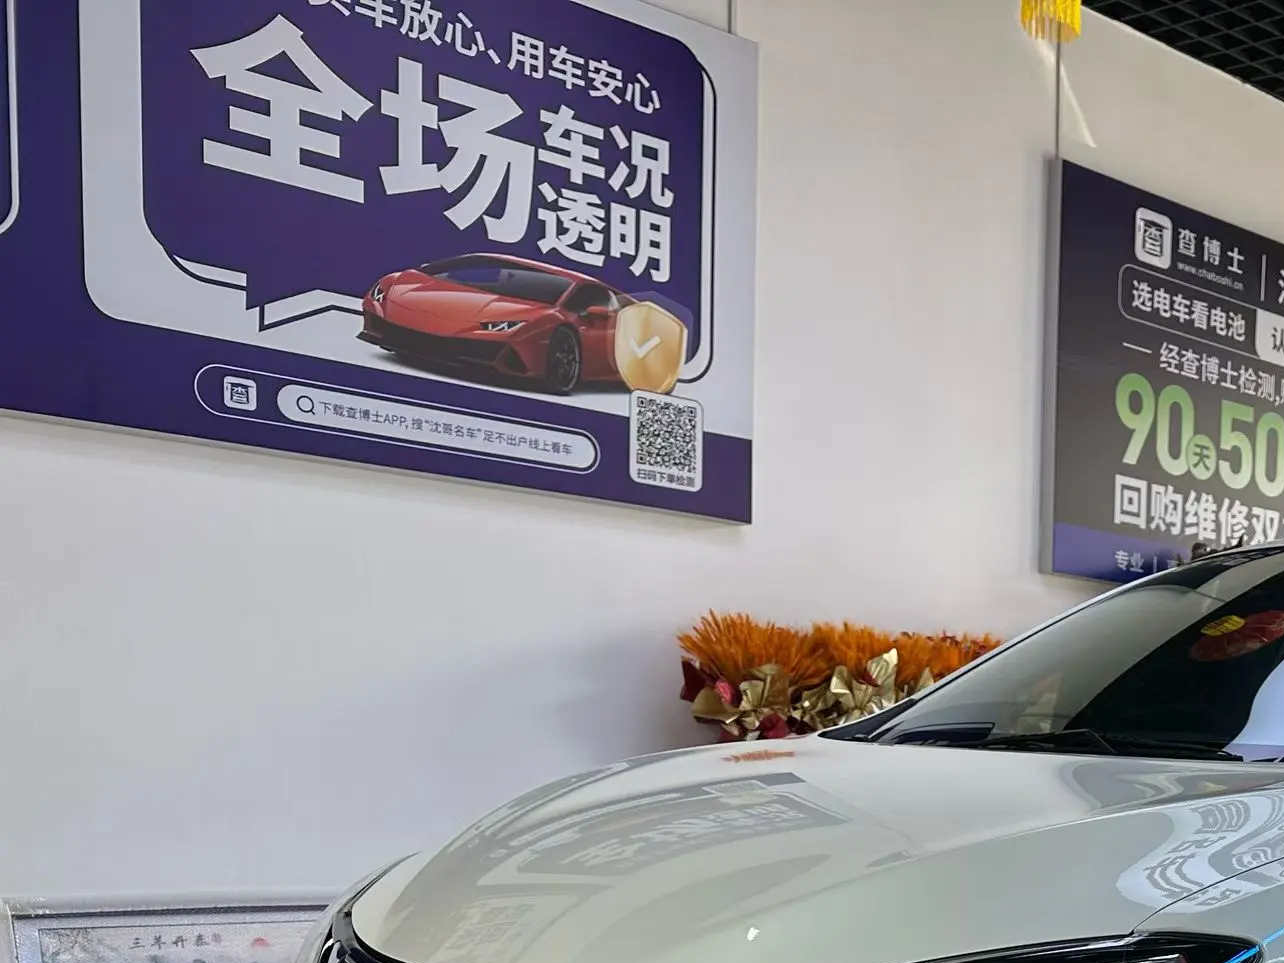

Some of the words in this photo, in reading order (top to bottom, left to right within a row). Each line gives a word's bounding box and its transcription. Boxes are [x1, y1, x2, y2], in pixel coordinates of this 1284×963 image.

[190, 14, 535, 243] 全场
[537, 105, 674, 208] 车况
[537, 182, 673, 283] 透明
[1177, 228, 1245, 274] 查博士
[1131, 279, 1247, 342] 选电车看电池
